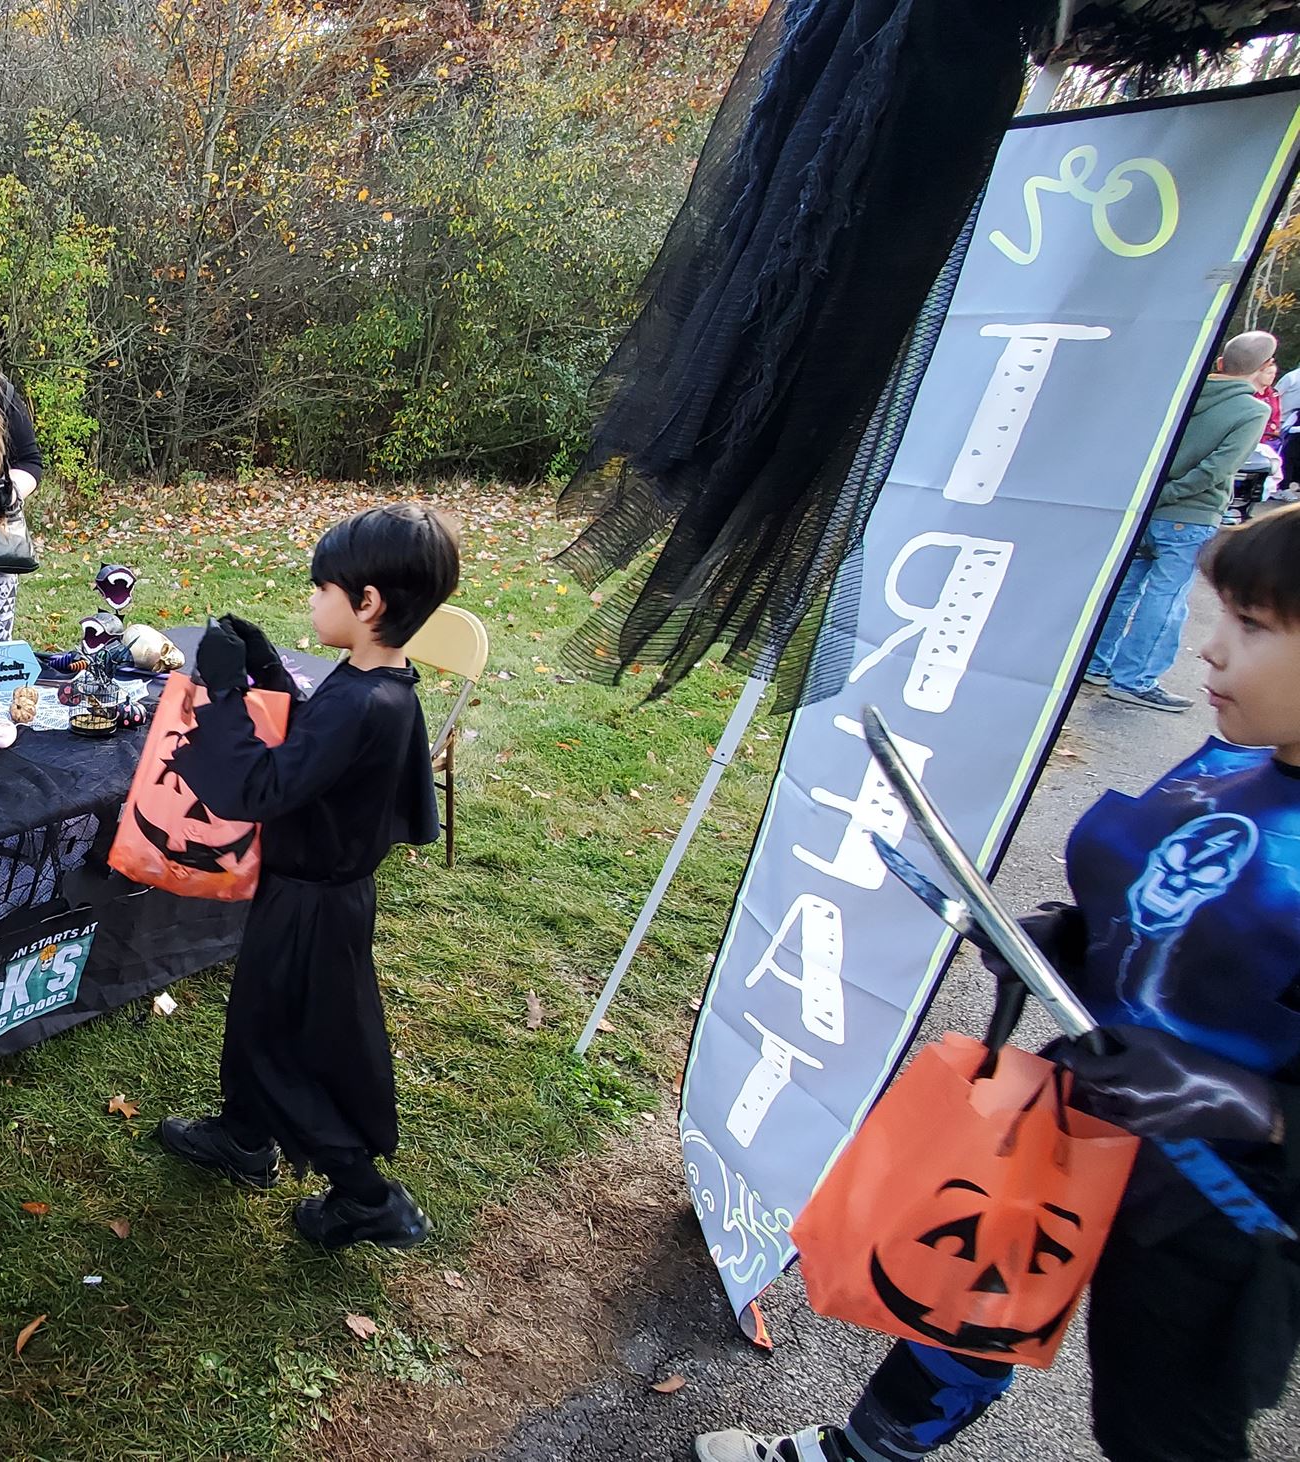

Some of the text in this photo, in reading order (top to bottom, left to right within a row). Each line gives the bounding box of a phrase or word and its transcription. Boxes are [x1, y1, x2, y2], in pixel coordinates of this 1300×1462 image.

[29, 921, 99, 953] STARTS AT
[13, 990, 70, 1021] GOODS
